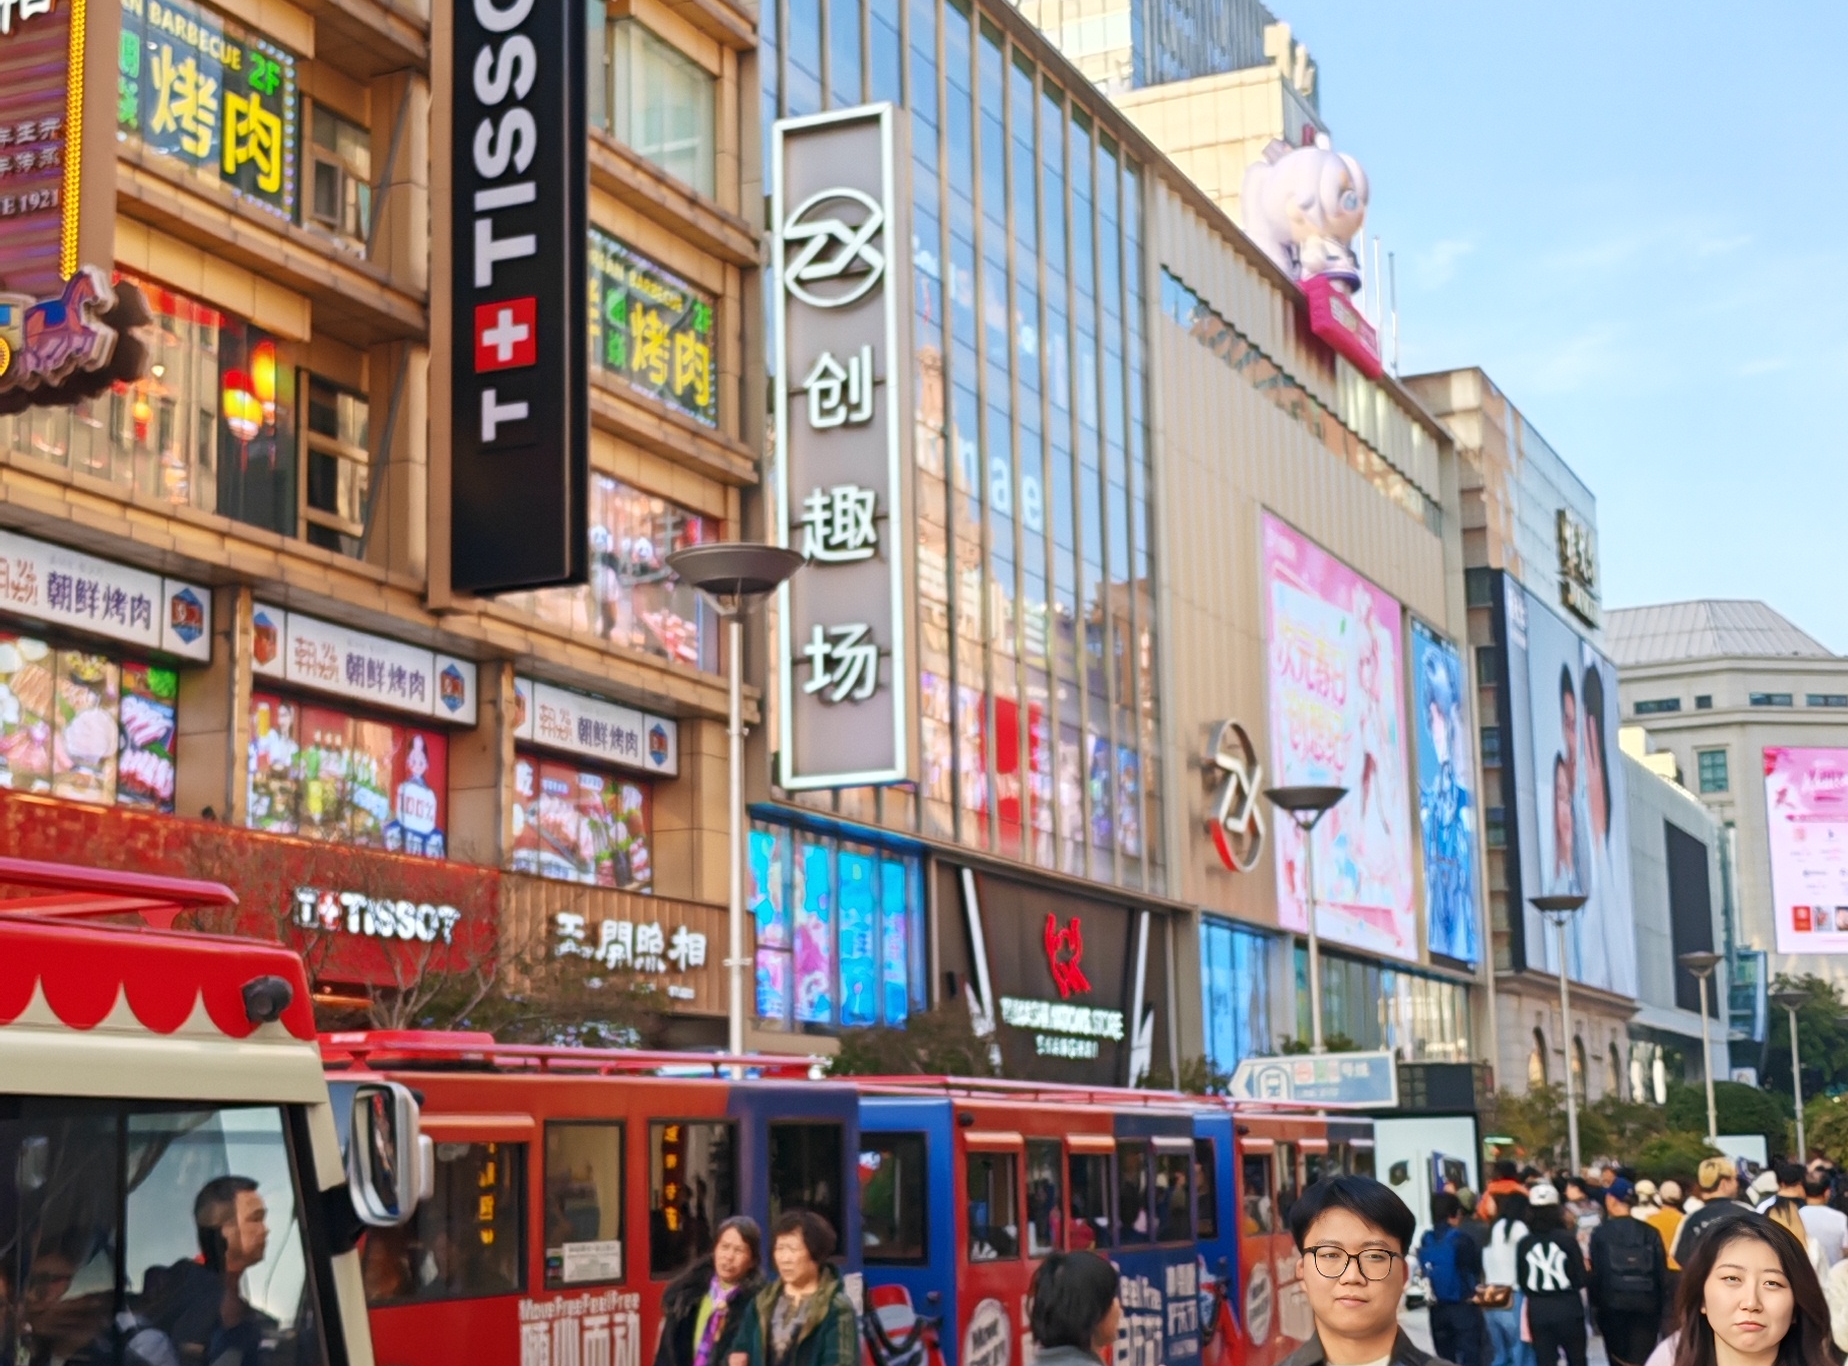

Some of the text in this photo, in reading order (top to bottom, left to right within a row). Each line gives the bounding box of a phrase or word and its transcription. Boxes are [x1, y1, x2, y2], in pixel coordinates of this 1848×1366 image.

[148, 0, 243, 71] BARBECUE
[249, 51, 281, 96] 2F
[151, 44, 282, 194] 烤肉
[20, 188, 60, 213] 1921
[630, 302, 710, 406] 烤肉
[802, 343, 878, 703] 创趣场
[47, 570, 152, 631] 朝鲜烤肉
[345, 651, 426, 703] 朝鲜烤肉
[340, 891, 461, 945] TISSOT
[1525, 1241, 1571, 1293] NY
